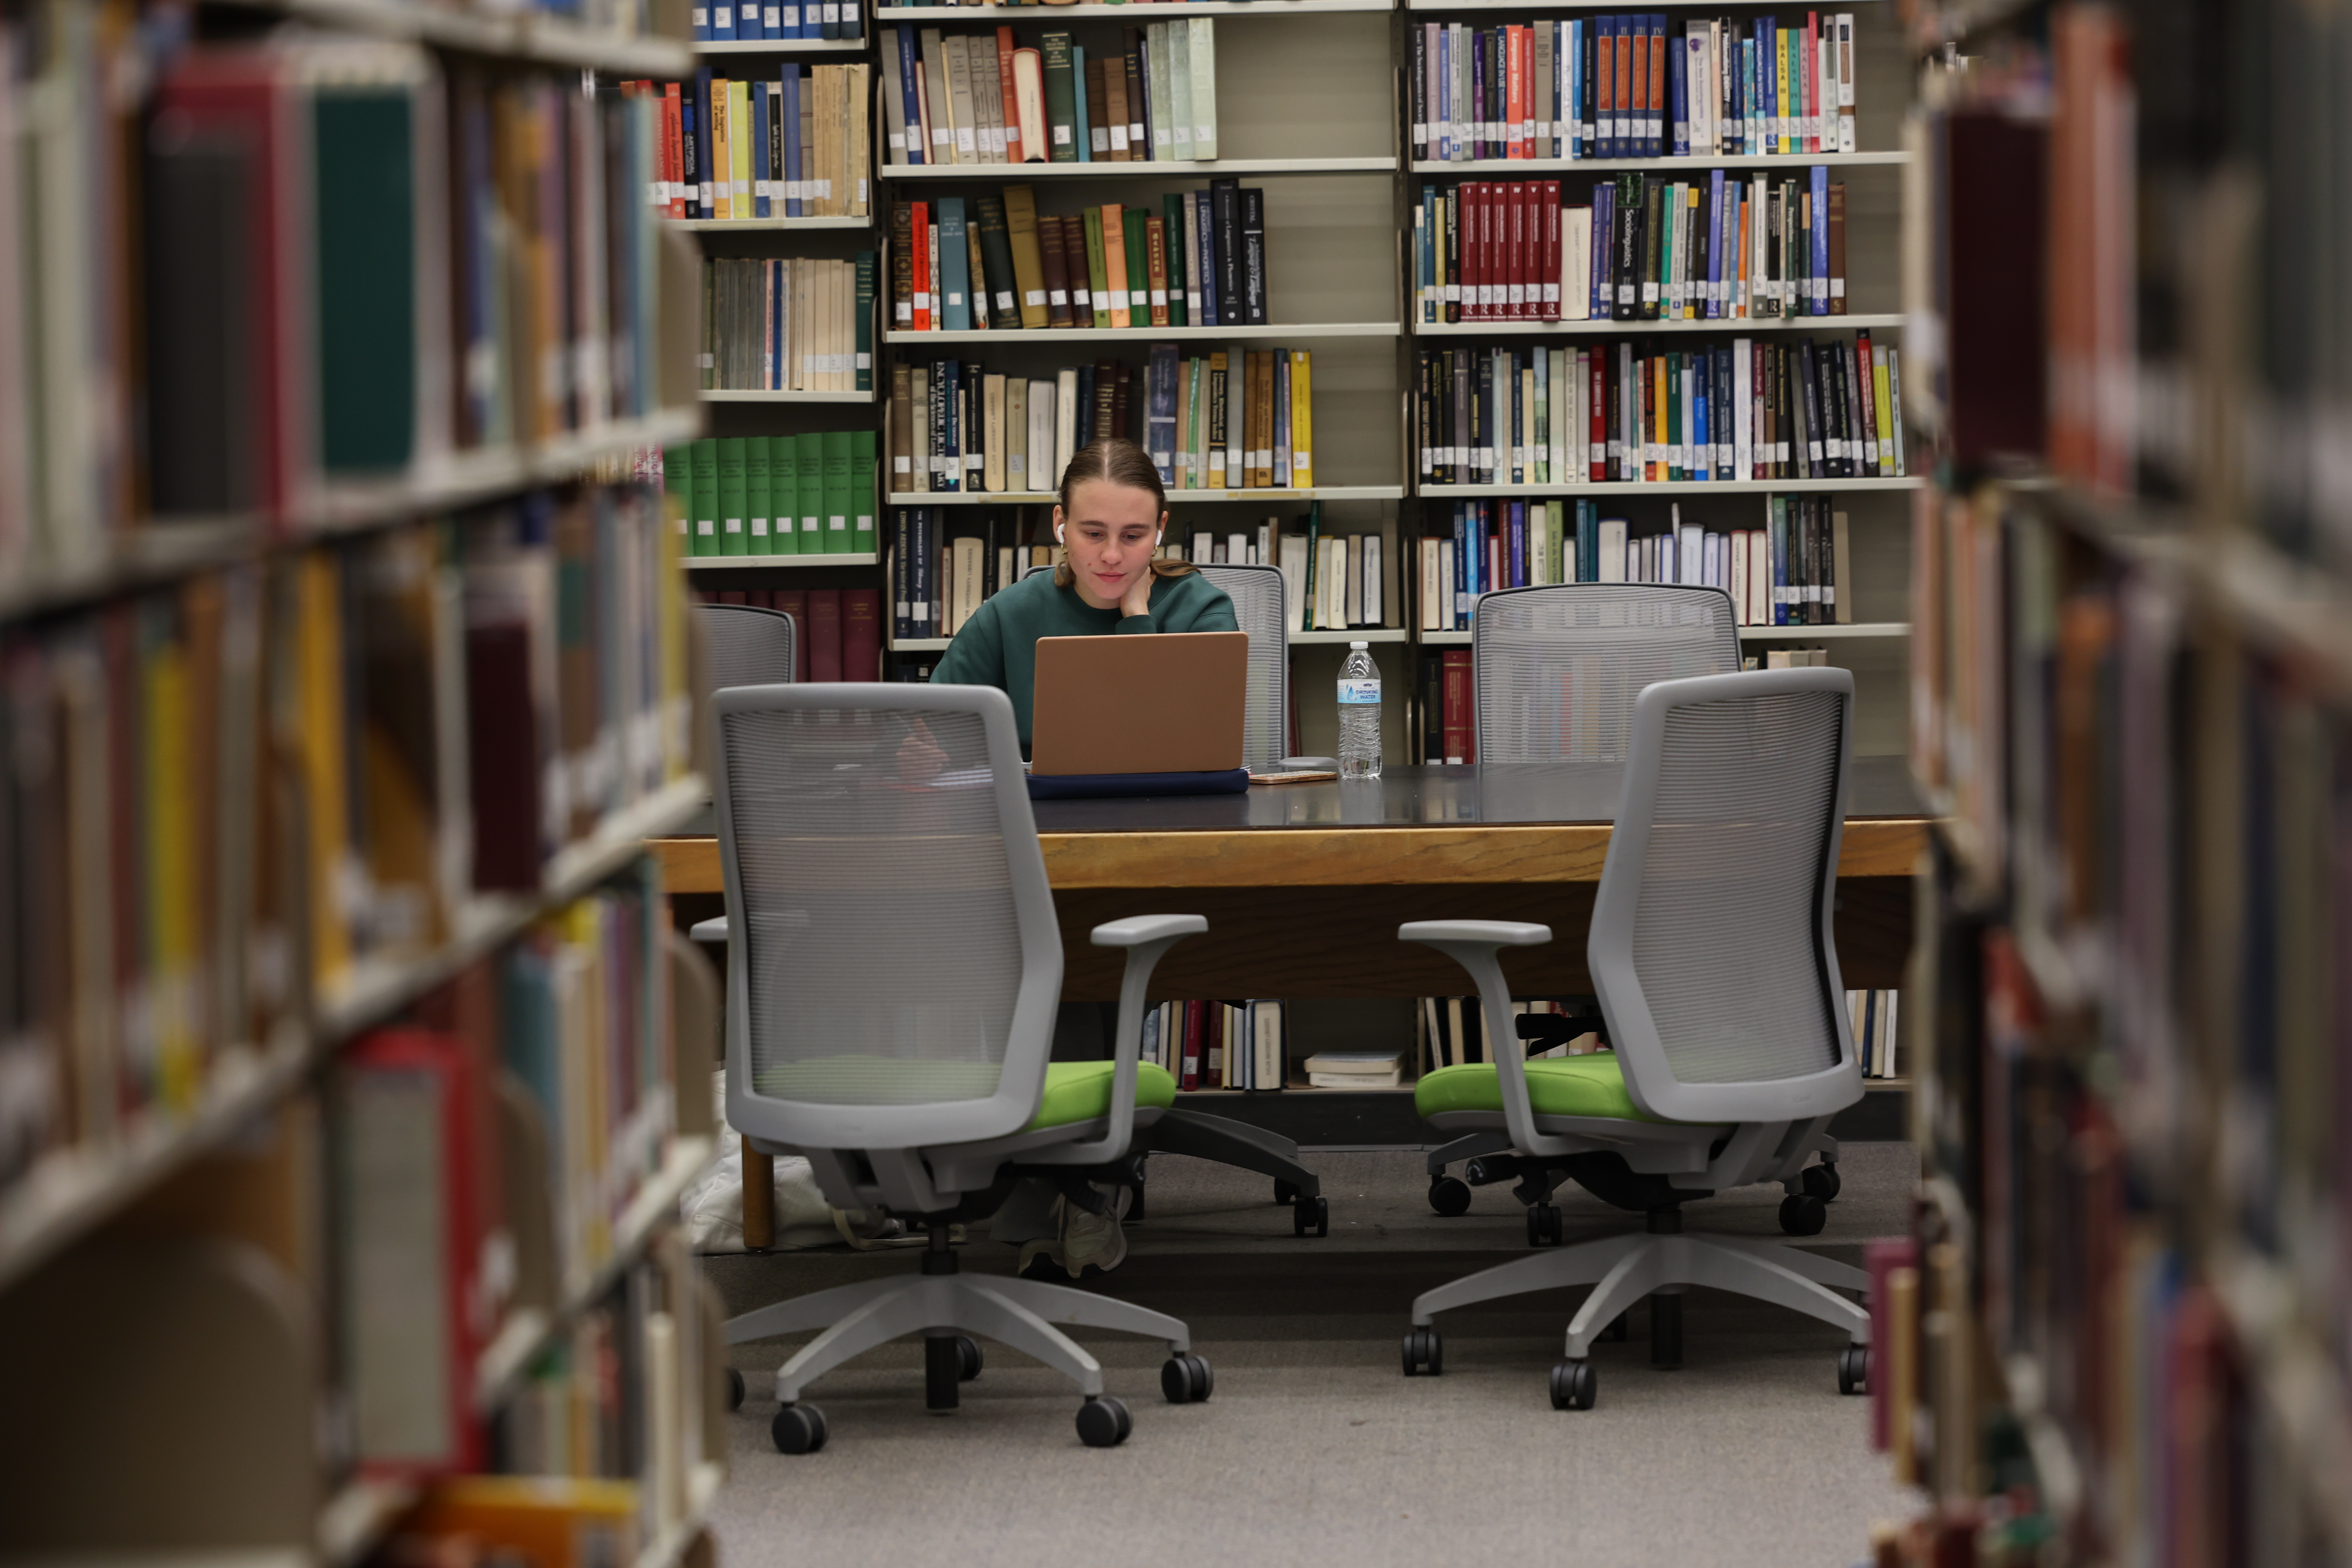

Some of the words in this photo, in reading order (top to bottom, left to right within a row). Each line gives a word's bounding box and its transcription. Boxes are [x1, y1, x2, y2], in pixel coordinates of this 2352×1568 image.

[1510, 33, 1519, 71] Language
[1200, 205, 1209, 242] LINGUISTICS
[1622, 208, 1635, 268] Sociolinguistics
